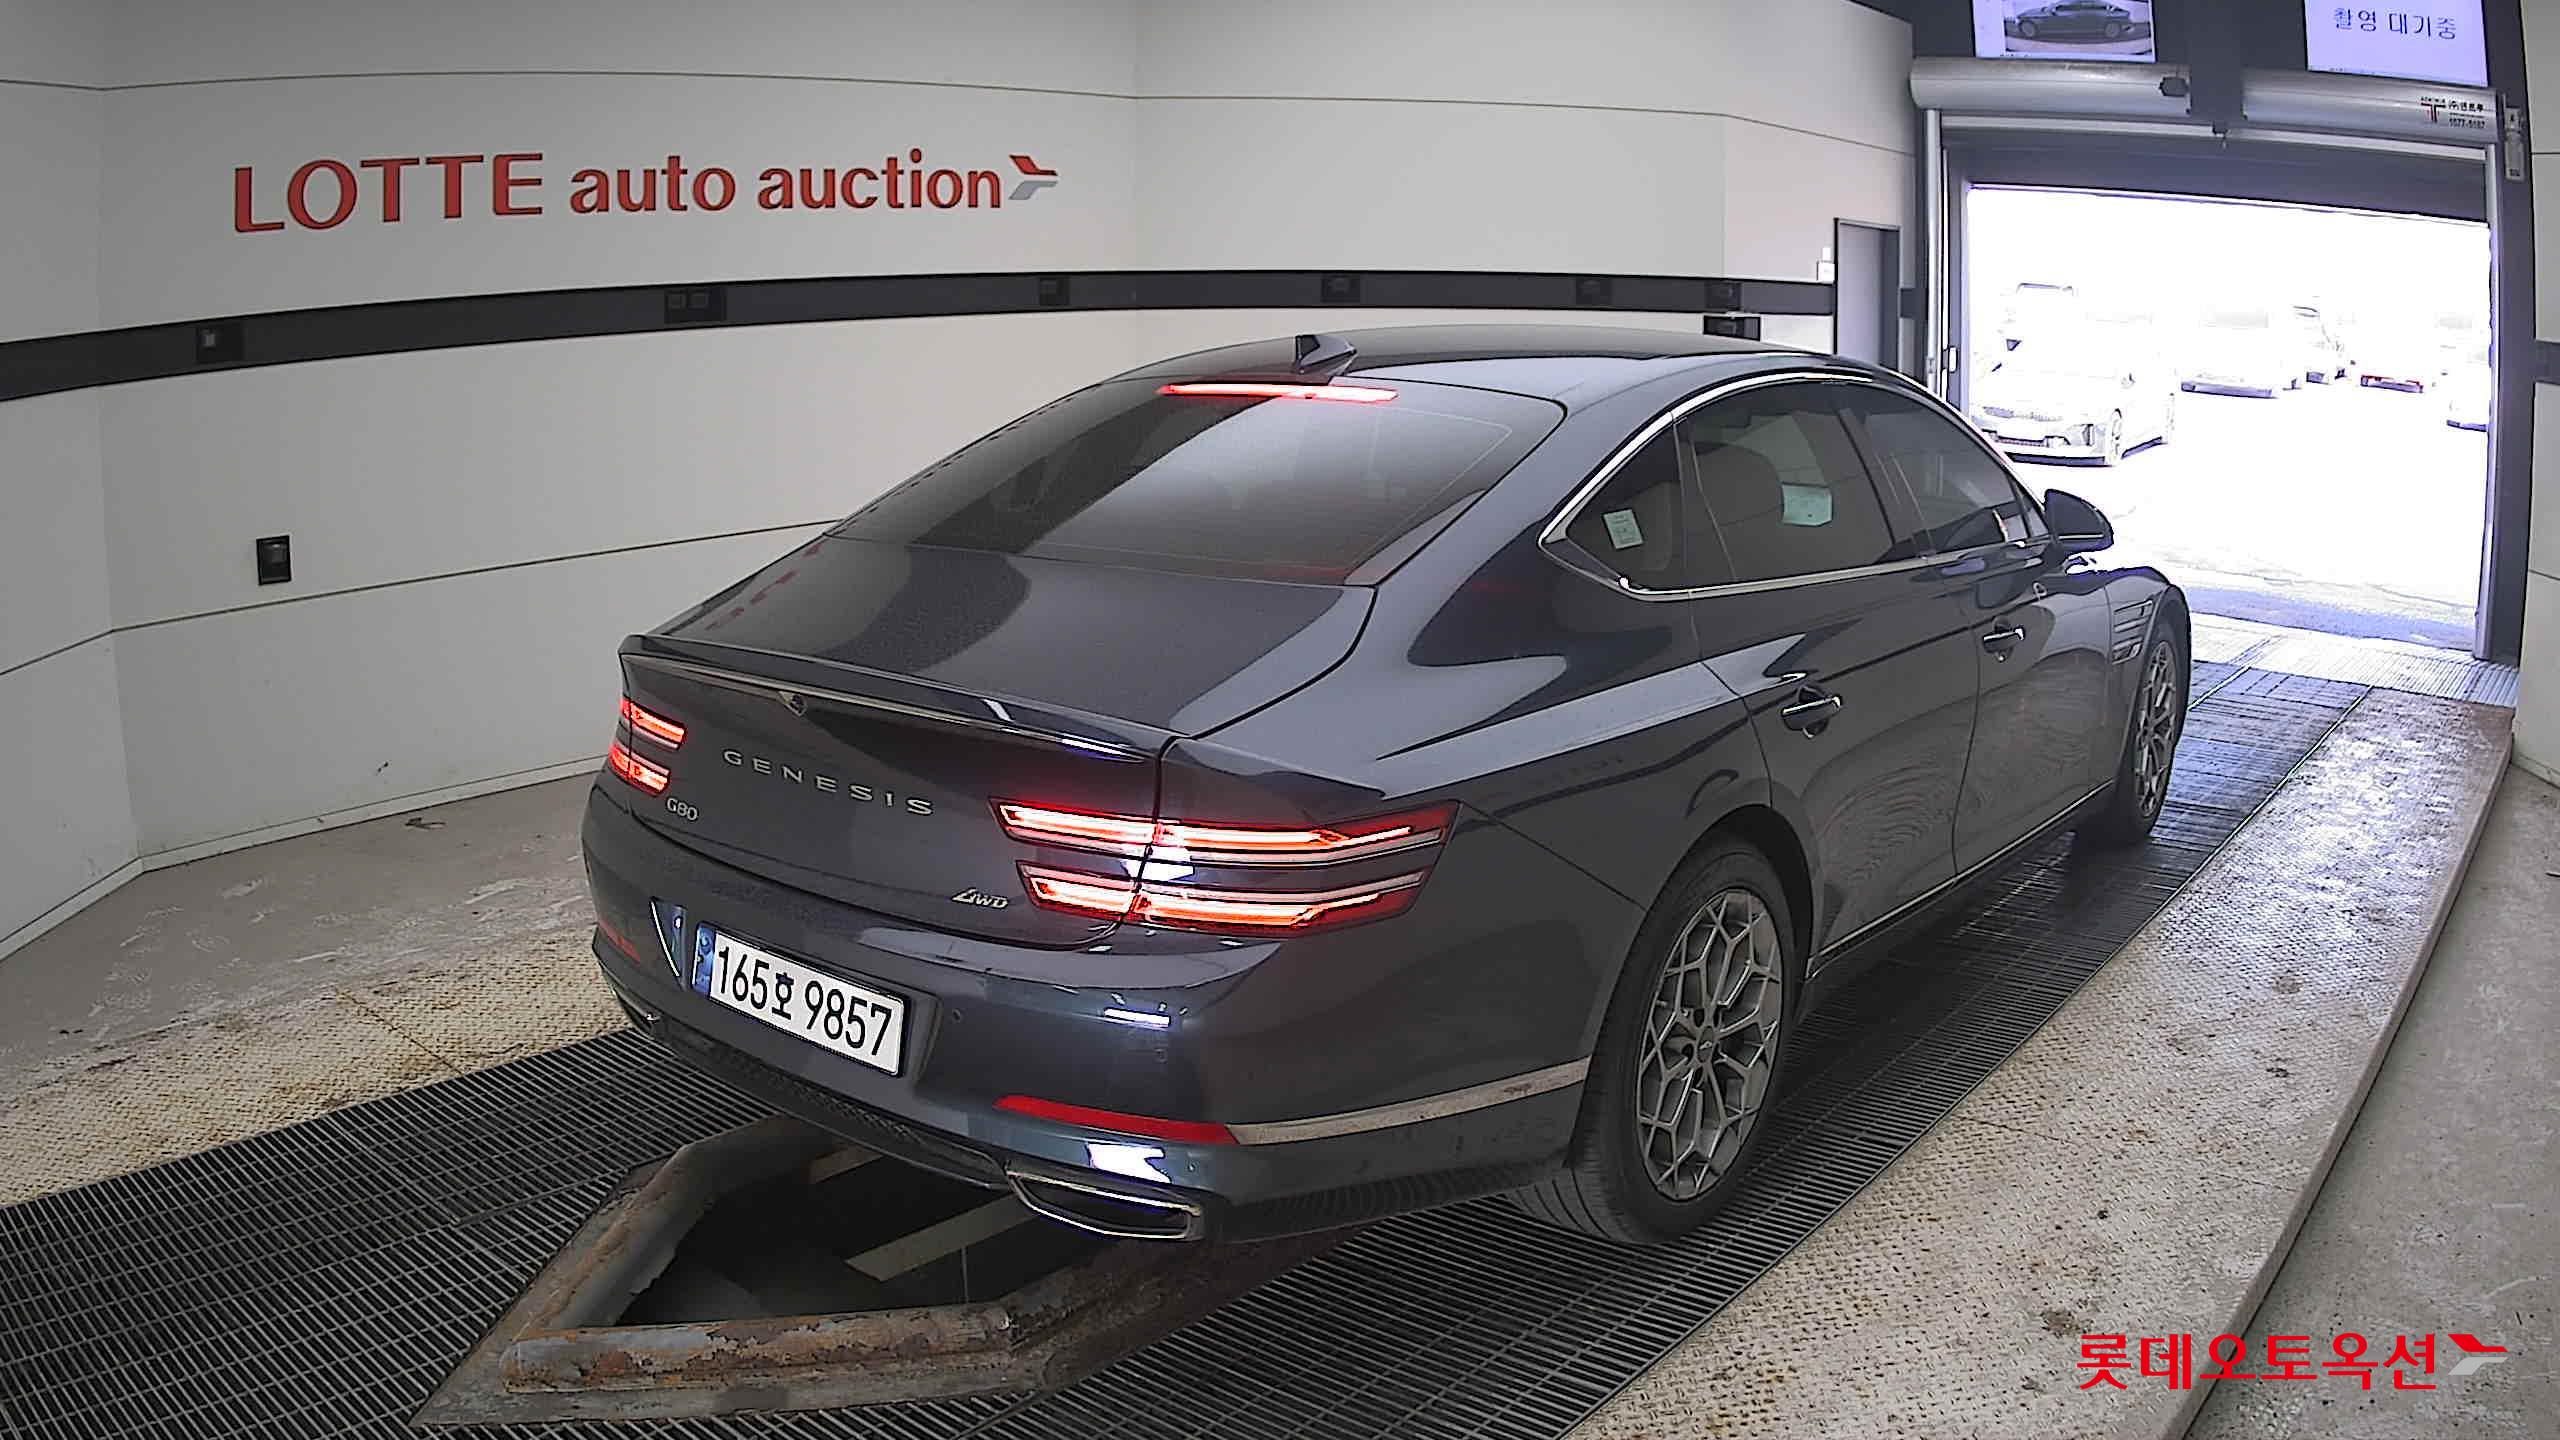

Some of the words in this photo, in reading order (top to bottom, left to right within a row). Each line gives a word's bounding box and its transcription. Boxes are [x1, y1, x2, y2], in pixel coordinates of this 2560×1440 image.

[2388, 12, 2456, 40] 대기중
[233, 153, 543, 233] LOTTE
[569, 156, 736, 214] auto
[756, 148, 1002, 211] auction
[666, 797, 700, 821] G80
[722, 750, 934, 816] GENESIS
[717, 945, 795, 1021] 165호
[804, 980, 893, 1056] 9857
